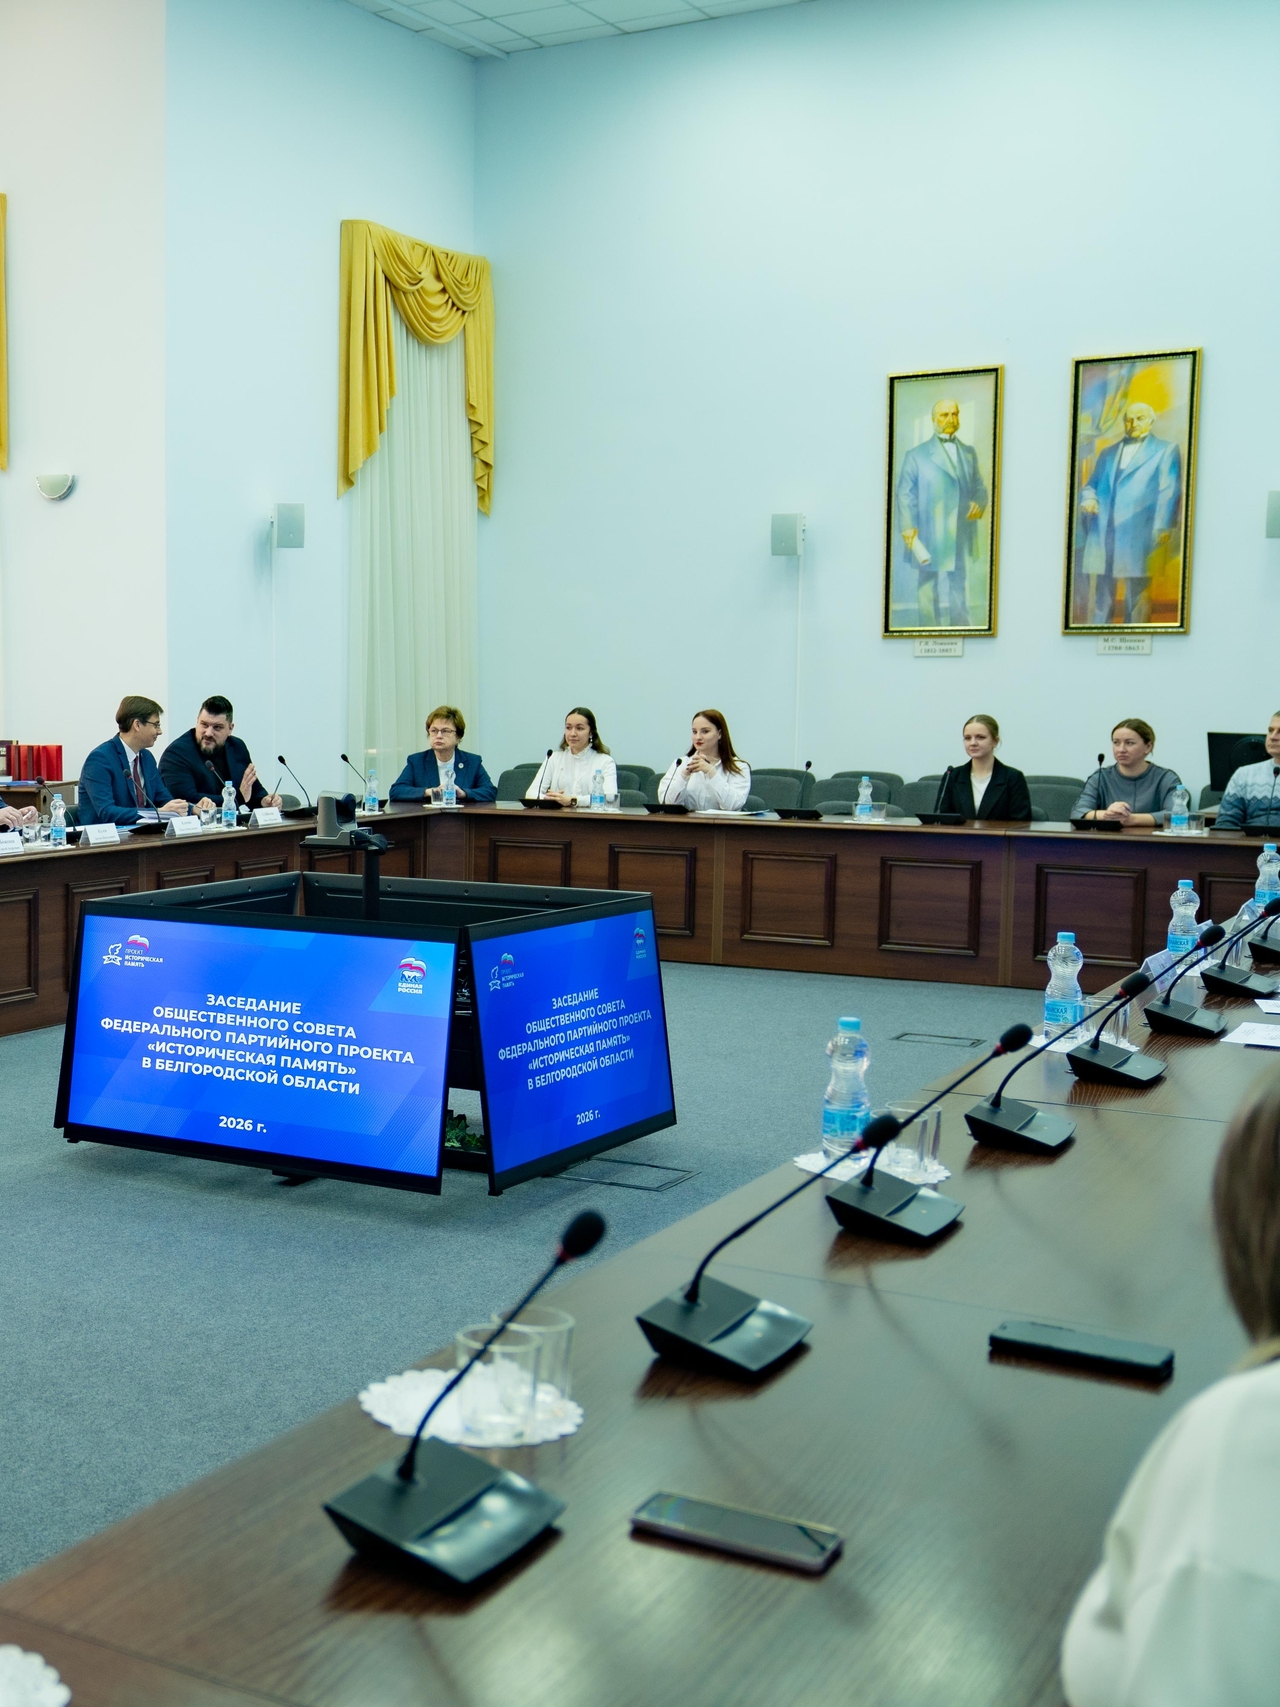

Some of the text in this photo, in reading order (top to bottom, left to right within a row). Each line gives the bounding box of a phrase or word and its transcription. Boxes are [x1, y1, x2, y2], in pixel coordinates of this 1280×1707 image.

[124, 955, 163, 963] ИСТОРИЧЕСКАЯ
[206, 994, 302, 1014] ЗАСЕДАНИЕ
[552, 988, 599, 1010] ЗАСЕДАНИЕ
[153, 1006, 356, 1039] ОБЩЕСТВЕННОГО СОВЕТА
[526, 999, 625, 1034] ОБЩЕСТВЕННОГО СОВЕТА
[100, 1017, 414, 1064] ФЕДЕРАЛЬНОГО ПАРТИЙНОГО ПРОЕКТА
[498, 1009, 652, 1061] ФЕДЕРАЛЬНОГО ПАРТИЙНОГО ПРОЕКТА
[528, 1033, 630, 1070] «ИСТОРИЧЕСКАЯ ПАМЯТЬ»
[147, 1041, 356, 1075] «ИСТОРИЧЕСКАЯ ПАМЯТЬ»
[528, 1049, 634, 1090] В БЕЛГОРОДСКОЙ ОБЛАСТИ
[142, 1057, 360, 1095] В БЕЛГОРОДСКОЙ ОБЛАСТИ
[219, 1116, 267, 1133] 2026 г.
[576, 1109, 600, 1125] 2026 г.
